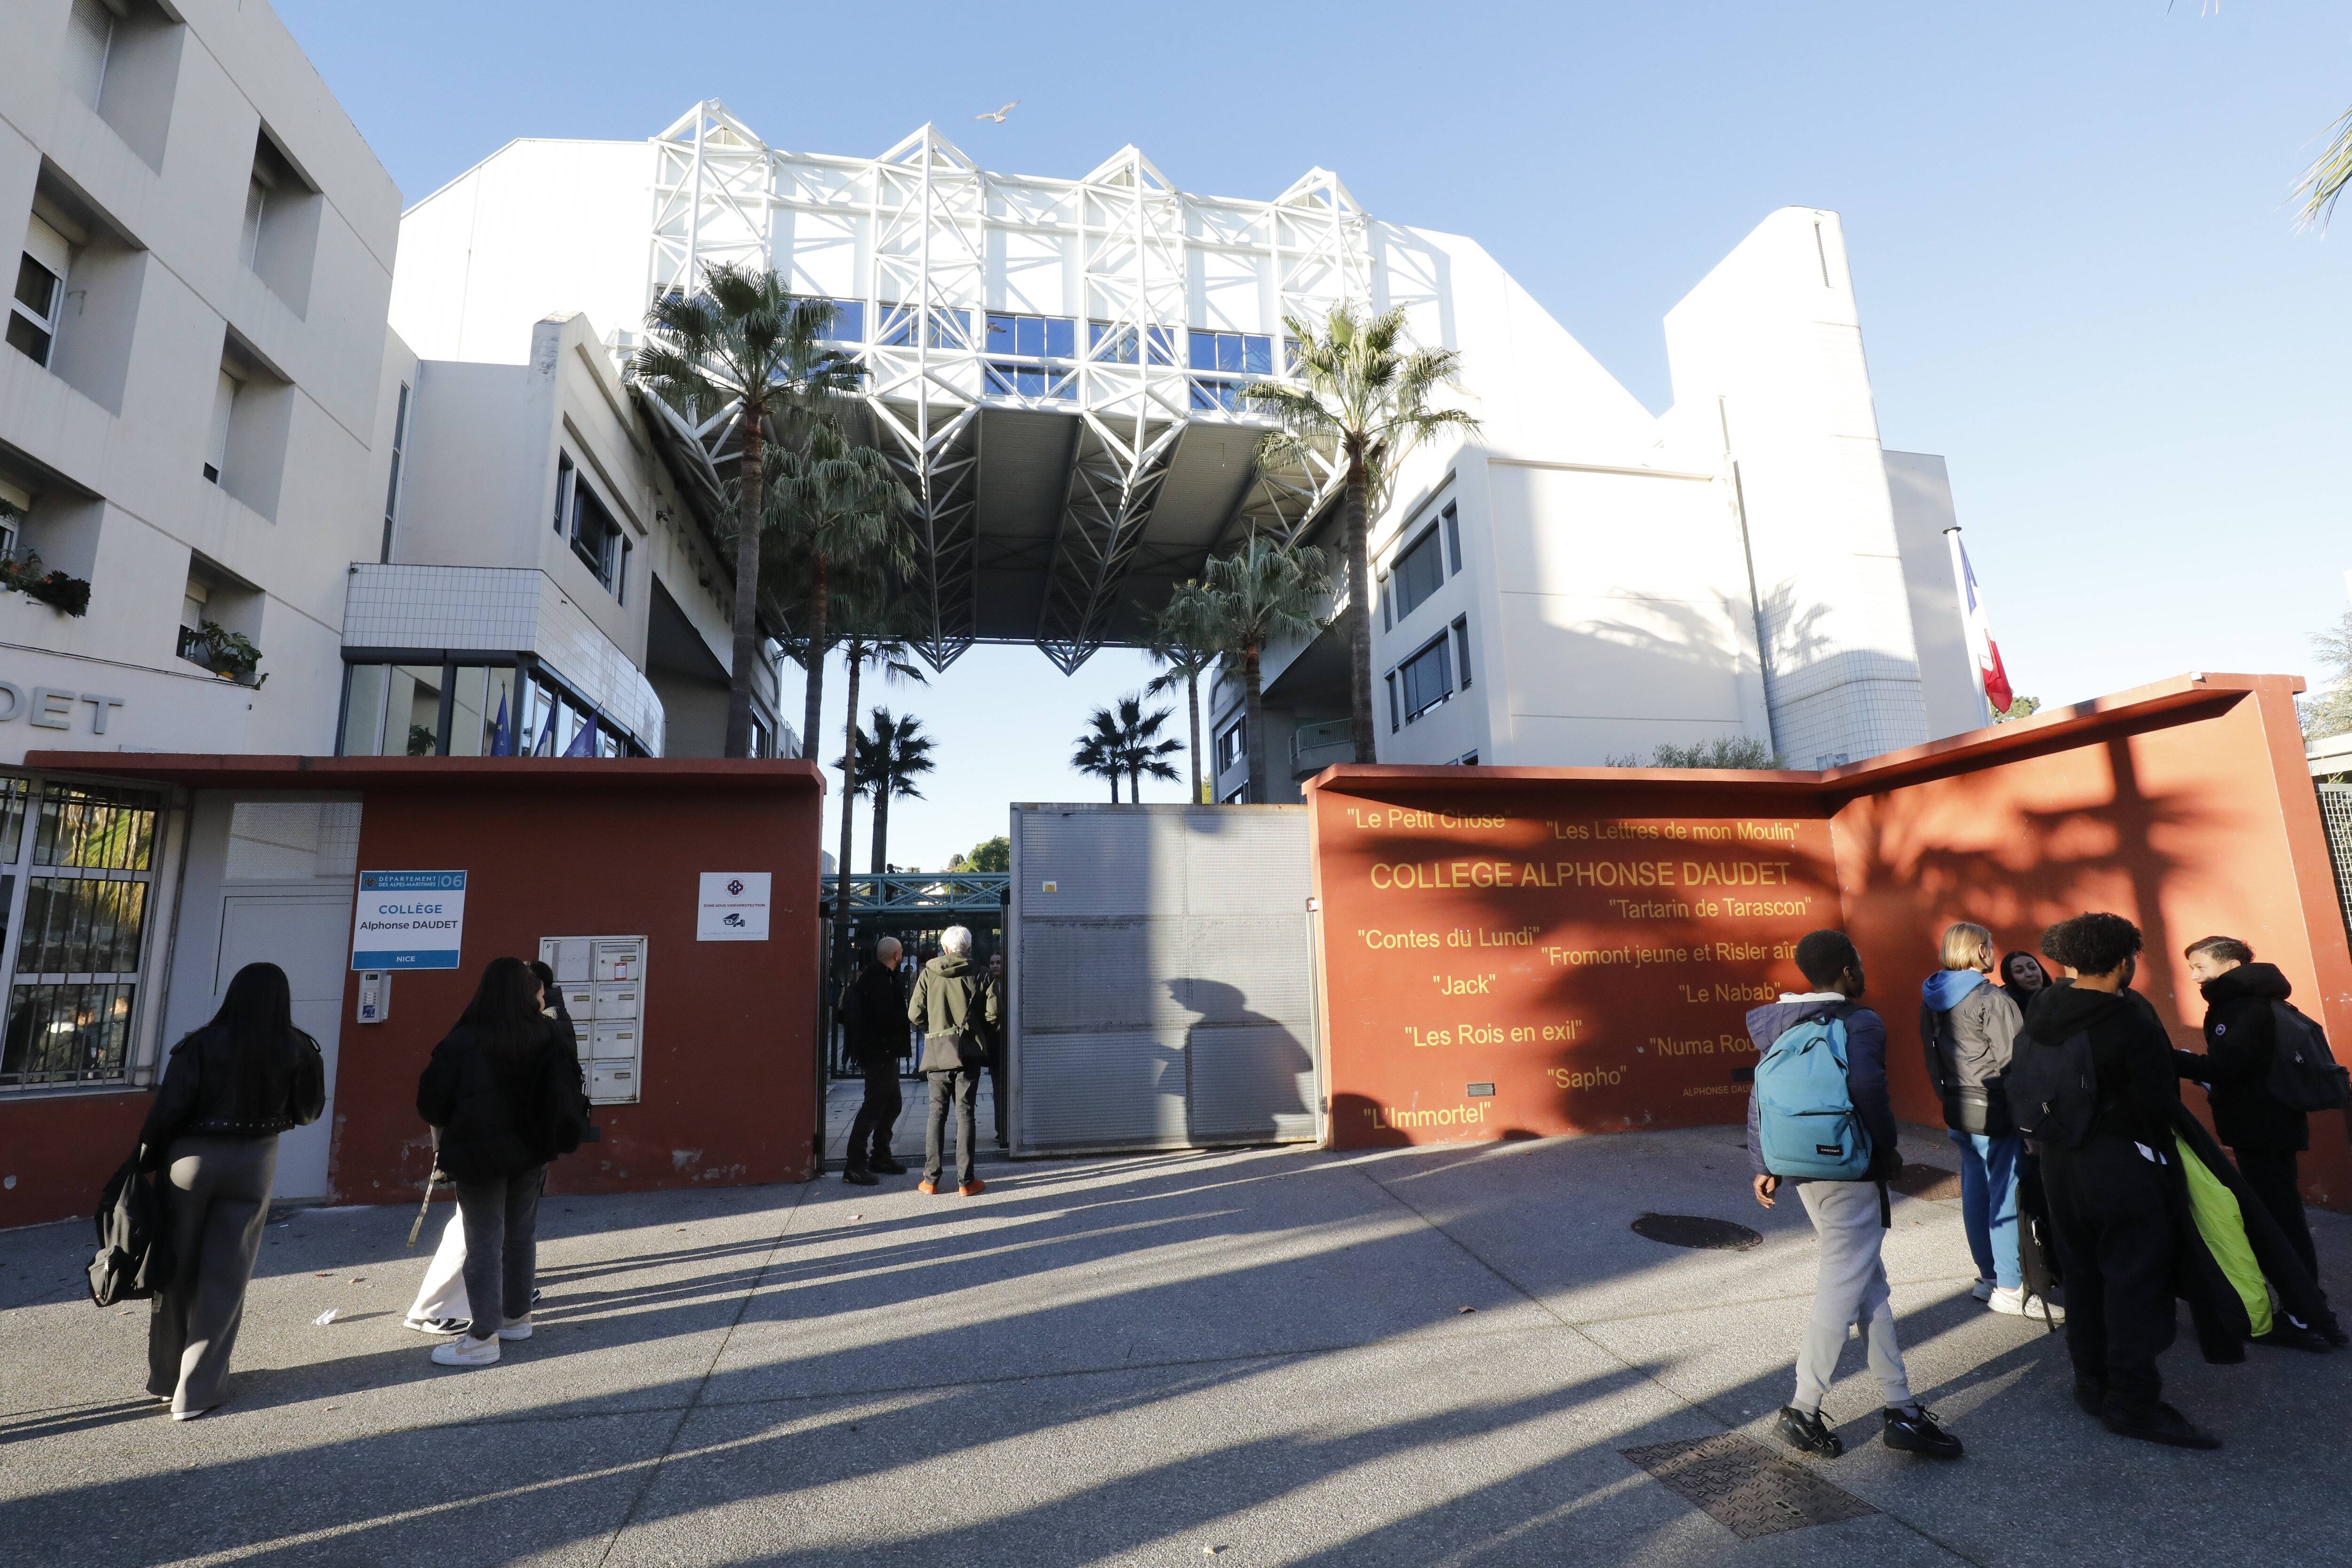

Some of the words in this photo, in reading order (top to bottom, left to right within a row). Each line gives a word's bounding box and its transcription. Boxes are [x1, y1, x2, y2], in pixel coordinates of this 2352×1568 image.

[1347, 808, 1382, 828] "Le
[1389, 809, 1434, 828] Petit
[1440, 809, 1511, 828] Chose"
[1547, 821, 1589, 840] "Les
[1595, 821, 1660, 840] Lettres
[1664, 821, 1687, 840] de
[1693, 826, 1732, 840] mon
[1737, 822, 1800, 840] Moulin"
[441, 875, 463, 887] 06
[1370, 861, 1514, 889] COLLEGE
[1520, 861, 1675, 887] ALPHONSE
[1683, 862, 1790, 885] DAUDET
[379, 903, 443, 915] COLLÈGE
[1609, 899, 1690, 919] "Tartarin
[1695, 898, 1718, 917] de
[1723, 896, 1811, 917] Tarascon"
[360, 921, 410, 931] Alphonse
[413, 920, 458, 930] DAUDET
[1358, 929, 1440, 949] "Contes
[1446, 928, 1472, 947] du
[1479, 926, 1540, 947] Lundi"
[1541, 946, 1630, 966] "Fromont
[1636, 944, 1687, 968] jeune
[1693, 944, 1711, 962] et
[1716, 942, 1767, 960] Risler
[1433, 974, 1496, 995] "Jack"
[1678, 984, 1709, 1003] "Le
[1716, 982, 1780, 1002] Nabab"
[1405, 1026, 1451, 1047] "Les
[1458, 1023, 1504, 1044] Rois
[1510, 1026, 1536, 1042] en
[1542, 1019, 1582, 1041] exil"
[1649, 1037, 1714, 1057] "Numa
[1547, 1065, 1627, 1091] "Sapho"
[1683, 1086, 1729, 1097] ALPHONSE
